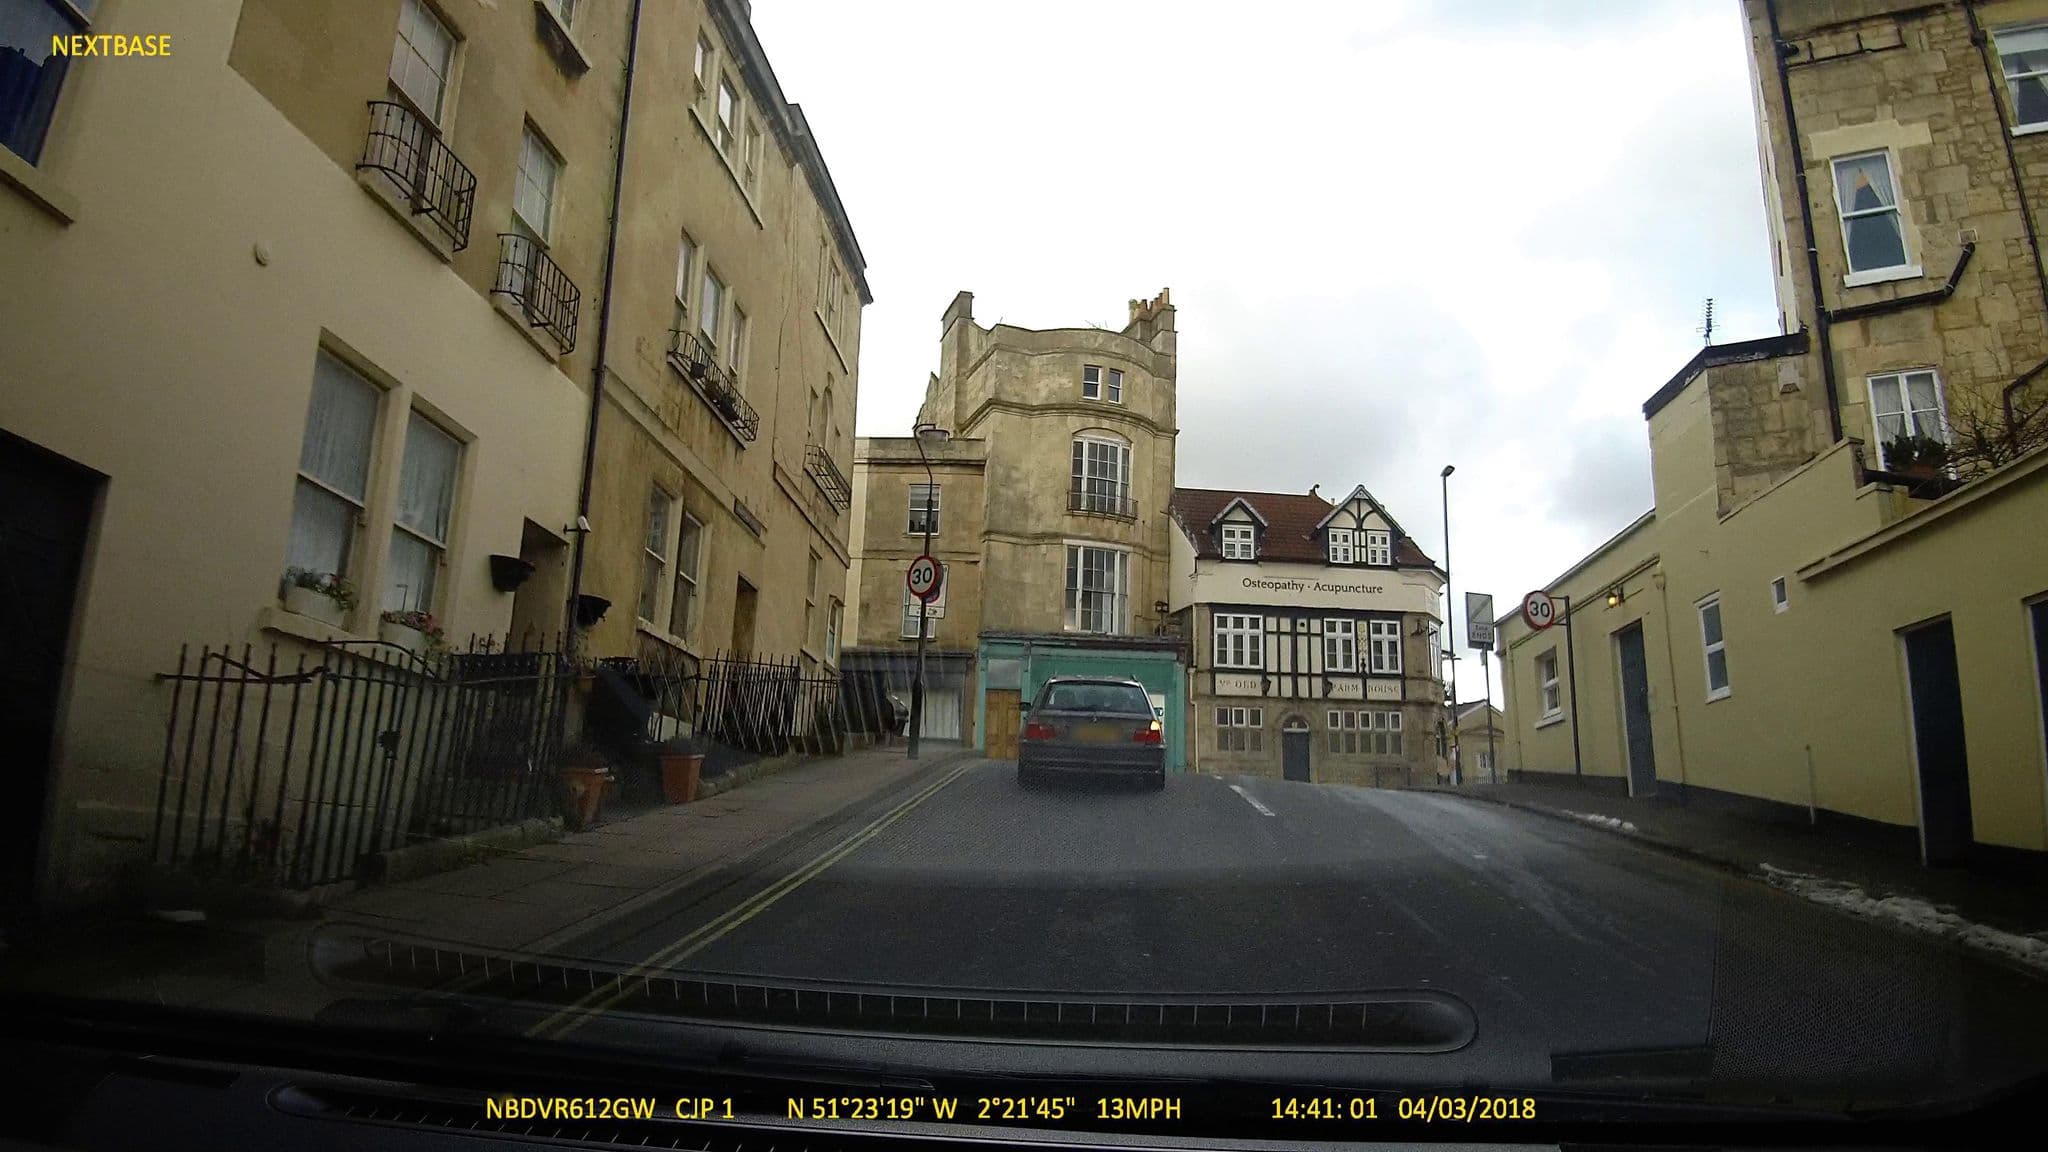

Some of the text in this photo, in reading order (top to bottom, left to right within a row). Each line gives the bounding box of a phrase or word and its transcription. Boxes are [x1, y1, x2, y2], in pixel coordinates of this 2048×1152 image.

[912, 567, 932, 584] 30
[1242, 577, 1383, 594] Osteopathy Acupuncture
[1530, 601, 1550, 617] 30
